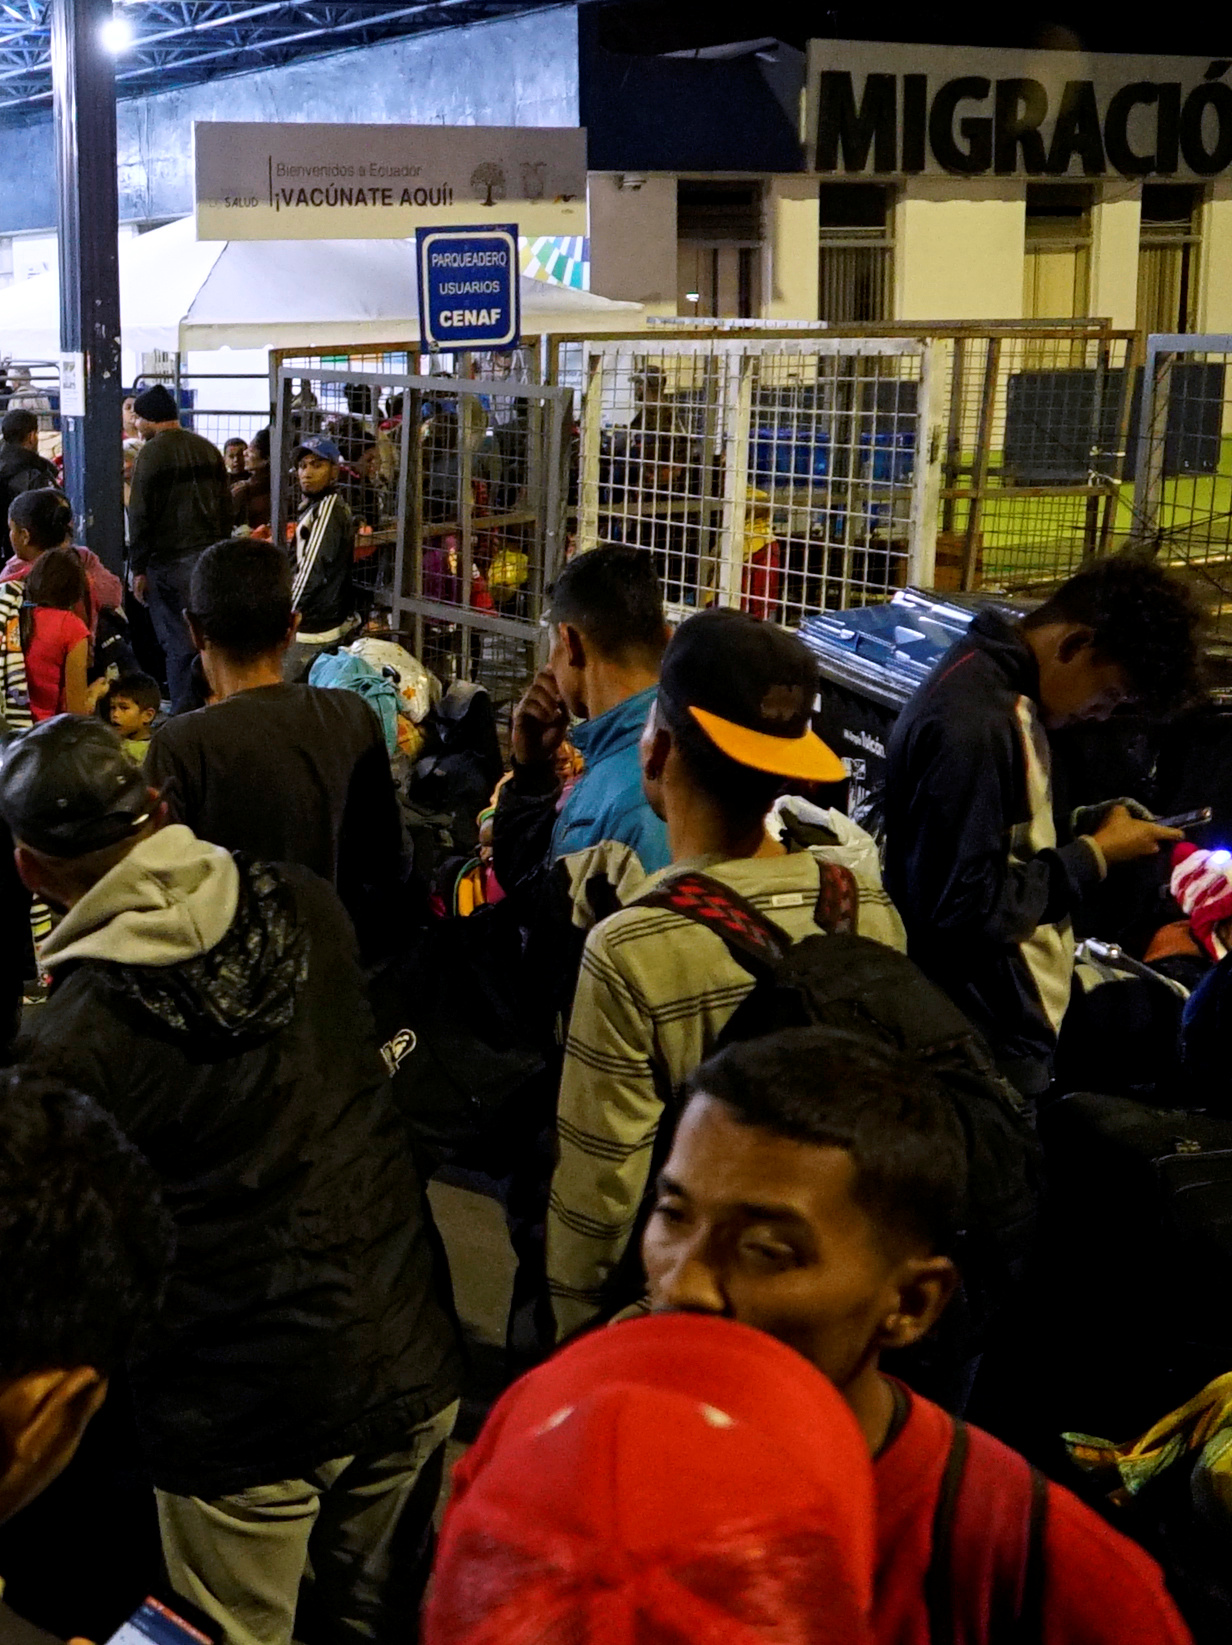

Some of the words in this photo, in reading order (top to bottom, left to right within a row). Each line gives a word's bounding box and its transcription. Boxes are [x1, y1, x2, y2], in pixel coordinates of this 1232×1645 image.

[276, 163, 355, 177] Bienvenidos
[359, 166, 366, 177] a
[370, 163, 422, 177] Ecuador
[224, 197, 259, 208] SALUD
[275, 182, 393, 212] ¡VACÚNATE
[400, 182, 453, 206] AQUÍ!
[431, 252, 508, 268] PARQUEADERO
[439, 281, 500, 295] USUARIOS
[439, 308, 503, 328] CENAF
